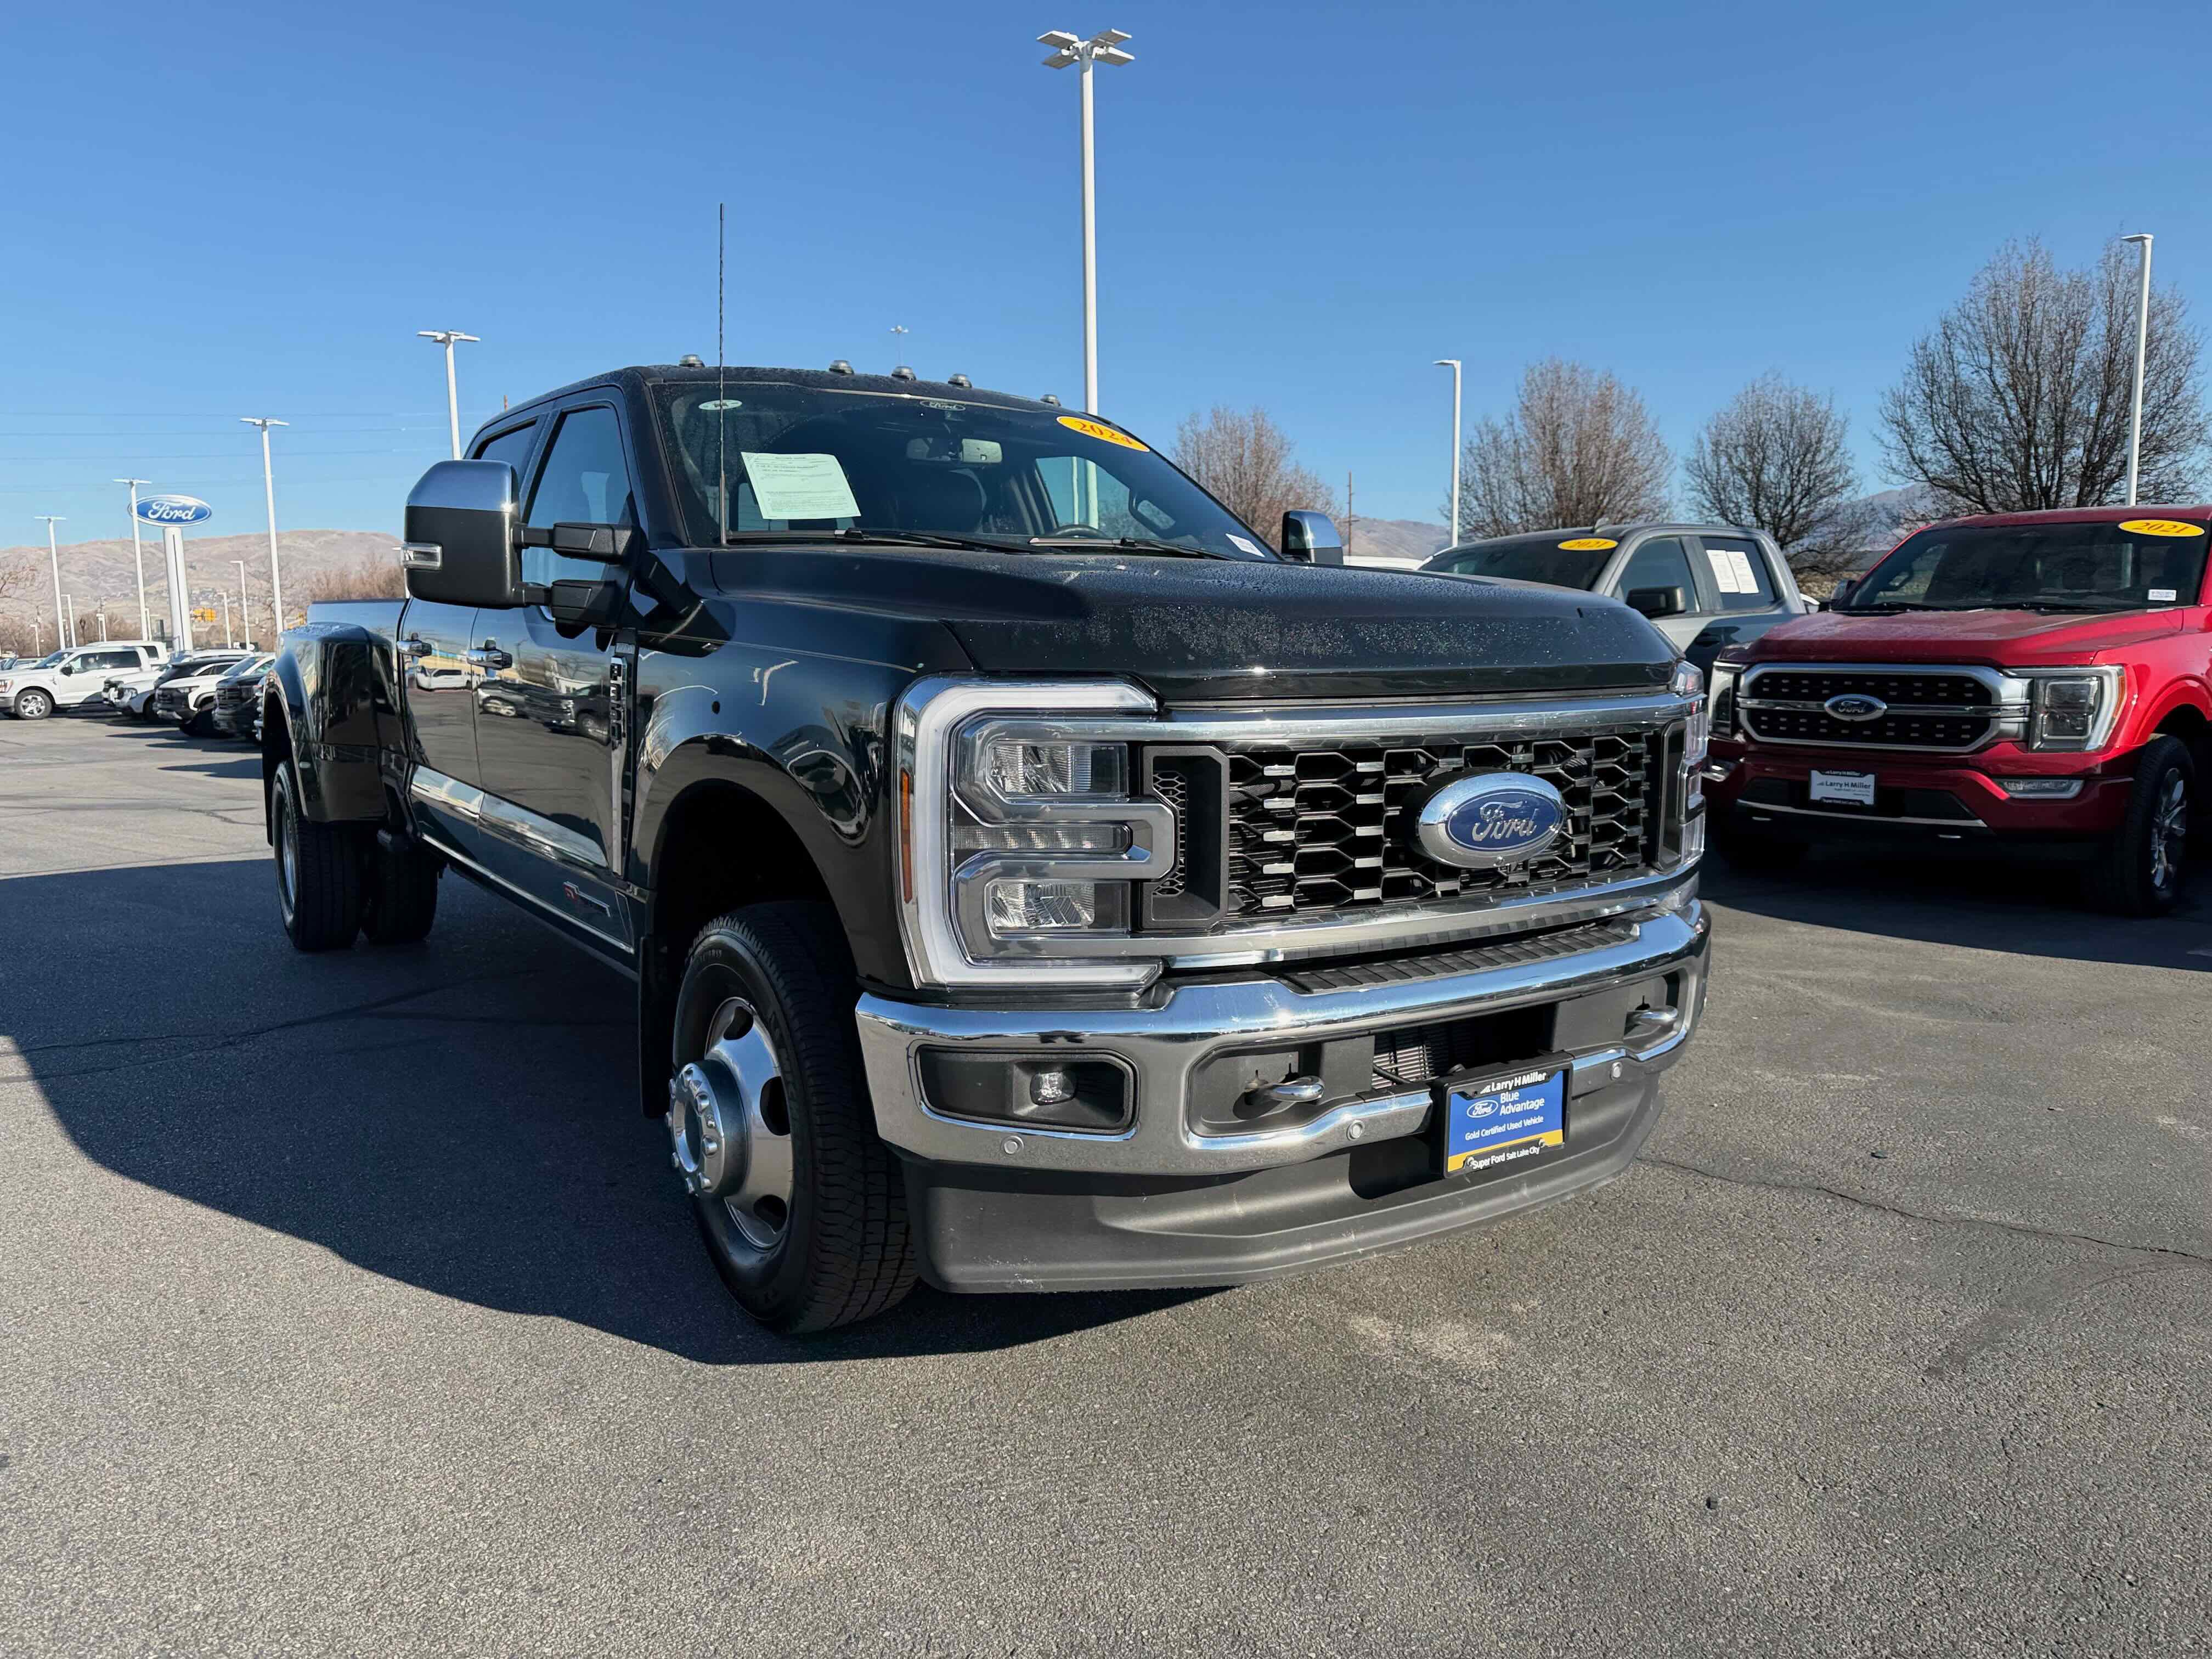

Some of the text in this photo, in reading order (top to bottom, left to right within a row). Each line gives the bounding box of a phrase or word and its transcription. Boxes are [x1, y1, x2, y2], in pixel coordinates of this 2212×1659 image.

[148, 501, 196, 520] Ford
[2134, 522, 2191, 533] 2021
[1838, 701, 1867, 713] Ford
[1472, 801, 1539, 841] Ford
[1492, 1071, 1547, 1091] Larry H Miller
[1500, 1091, 1519, 1104] Blue
[1472, 1102, 1492, 1116] Ford
[1499, 1098, 1544, 1116] Advantage
[1465, 1115, 1544, 1141] Gold Certified Used Vehicle
[1472, 1158, 1489, 1170] Super
[1491, 1153, 1505, 1164] Ford
[1530, 1146, 1540, 1155] City
